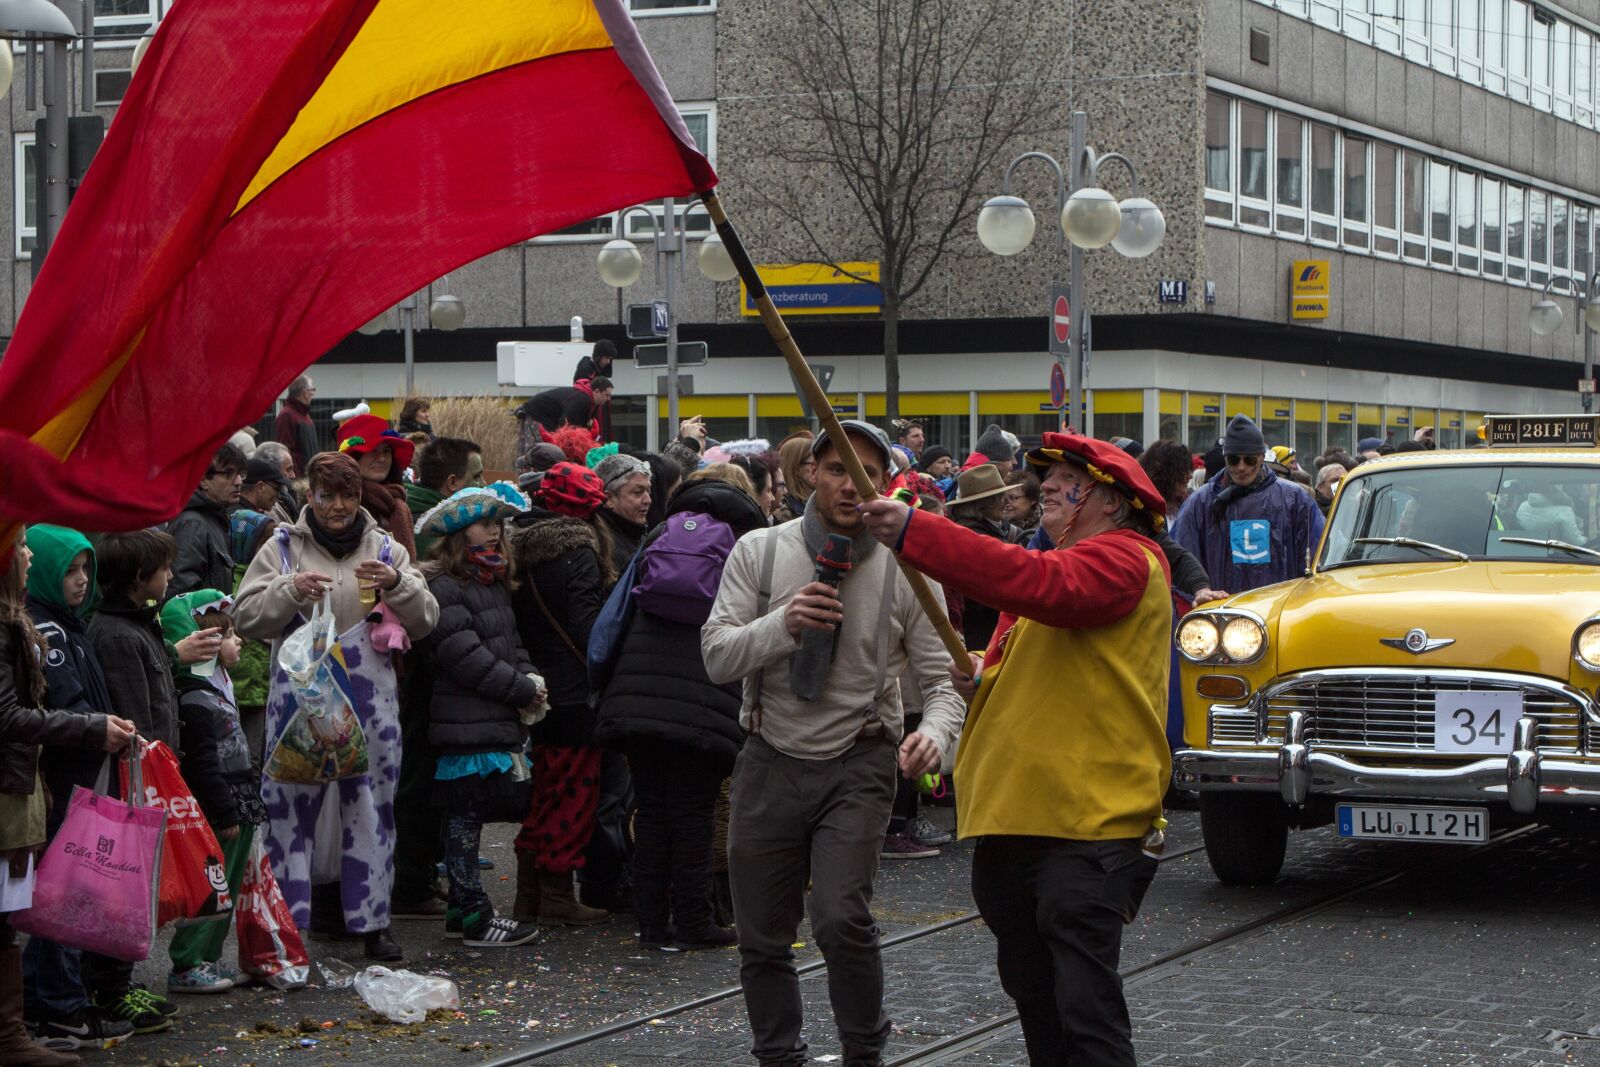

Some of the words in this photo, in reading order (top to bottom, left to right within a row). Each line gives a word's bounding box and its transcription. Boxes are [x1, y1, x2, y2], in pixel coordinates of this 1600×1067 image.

[771, 291, 828, 303] nzberatung
[1161, 281, 1183, 296] M1
[656, 309, 668, 327] N1
[1244, 528, 1257, 550] L
[1451, 708, 1505, 746] 34
[64, 842, 92, 859] Bella
[96, 852, 142, 874] Mondini
